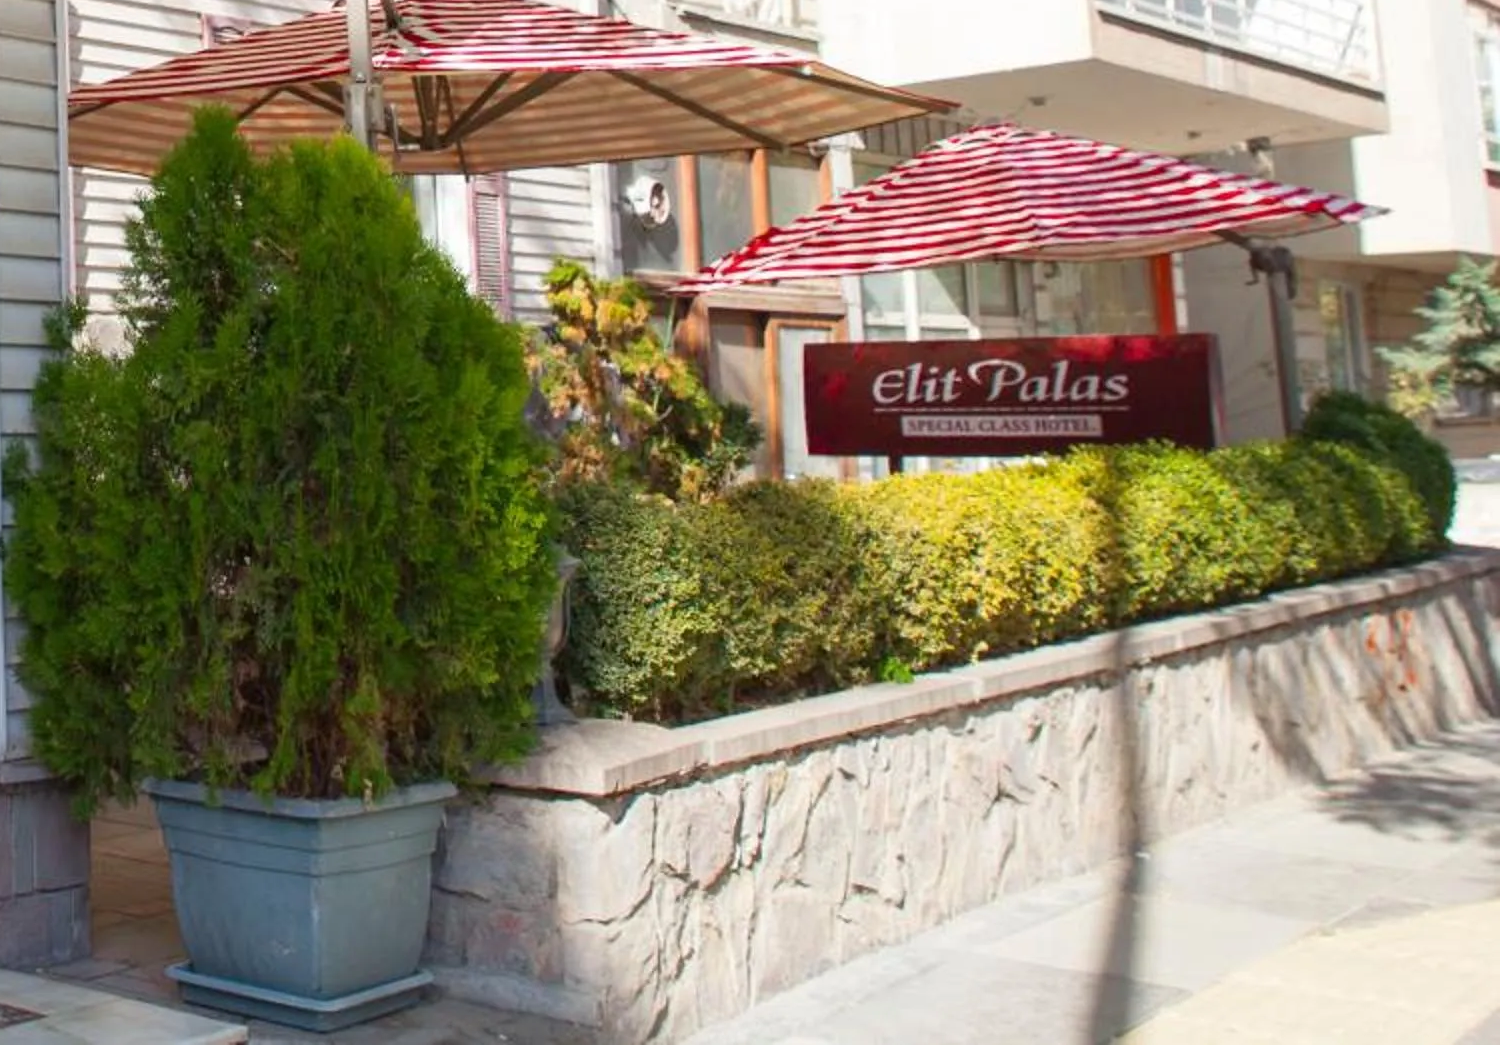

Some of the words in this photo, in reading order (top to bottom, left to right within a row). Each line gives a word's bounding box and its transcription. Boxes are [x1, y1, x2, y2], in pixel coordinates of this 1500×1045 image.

[872, 362, 963, 403] Elit
[967, 358, 1129, 402] Palas
[907, 418, 975, 433] SPECIAL
[978, 418, 1031, 433] CLASS
